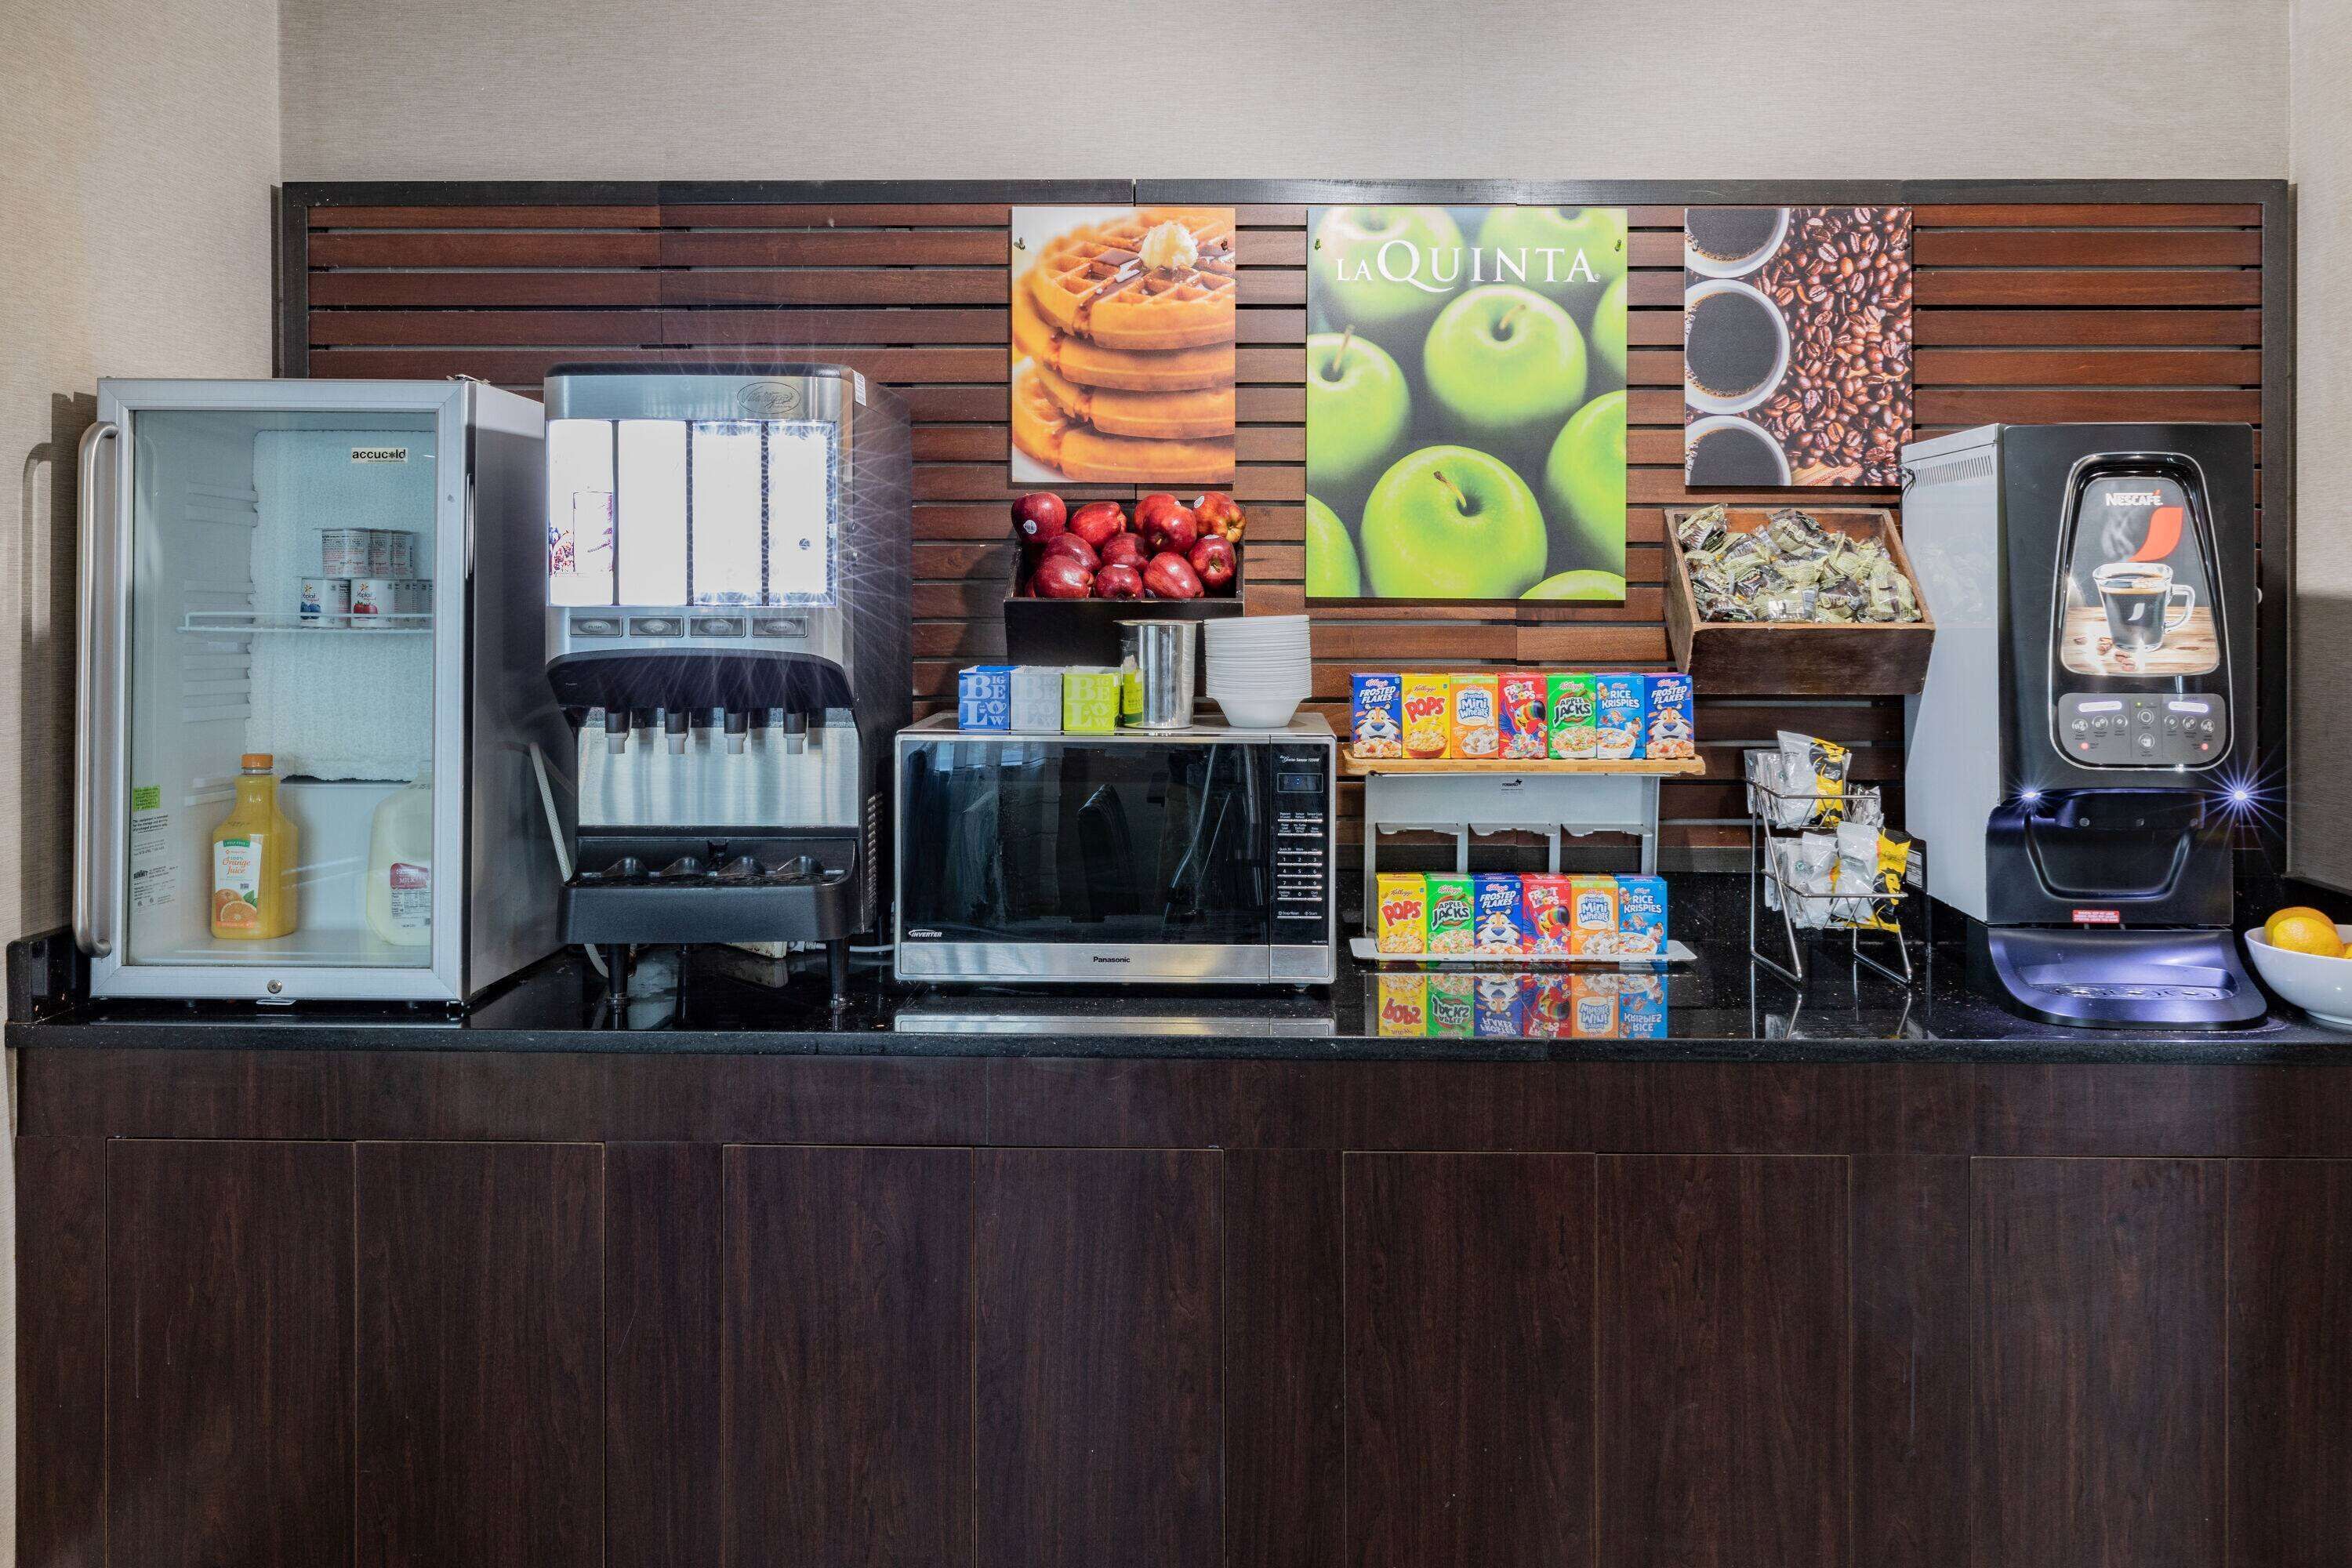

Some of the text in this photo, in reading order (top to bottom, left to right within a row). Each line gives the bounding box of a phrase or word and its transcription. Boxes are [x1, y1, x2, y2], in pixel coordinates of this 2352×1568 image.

[1336, 240, 1599, 292] LA QUINTA
[1359, 686, 1396, 699] FROSTED
[1610, 690, 1632, 699] RICE
[1651, 685, 1687, 698] FROSTED
[1361, 694, 1392, 704] FLAKES
[1461, 699, 1488, 709] Mini
[1602, 699, 1640, 710] KRISPIES
[1653, 694, 1685, 705] FLAKES
[1404, 696, 1446, 724] POPS
[1458, 707, 1490, 719] Wheats
[1553, 703, 1592, 724] JACKS
[227, 866, 245, 875] Juice
[1479, 891, 1516, 902] FROSTED
[1632, 895, 1653, 905] RICE
[1482, 898, 1512, 908] FLAKES
[1581, 902, 1607, 913] Mini
[1381, 901, 1423, 927] POPS
[1624, 904, 1662, 914] KRISPIES
[1431, 907, 1469, 931] JACKS
[1579, 910, 1609, 922] Wheats
